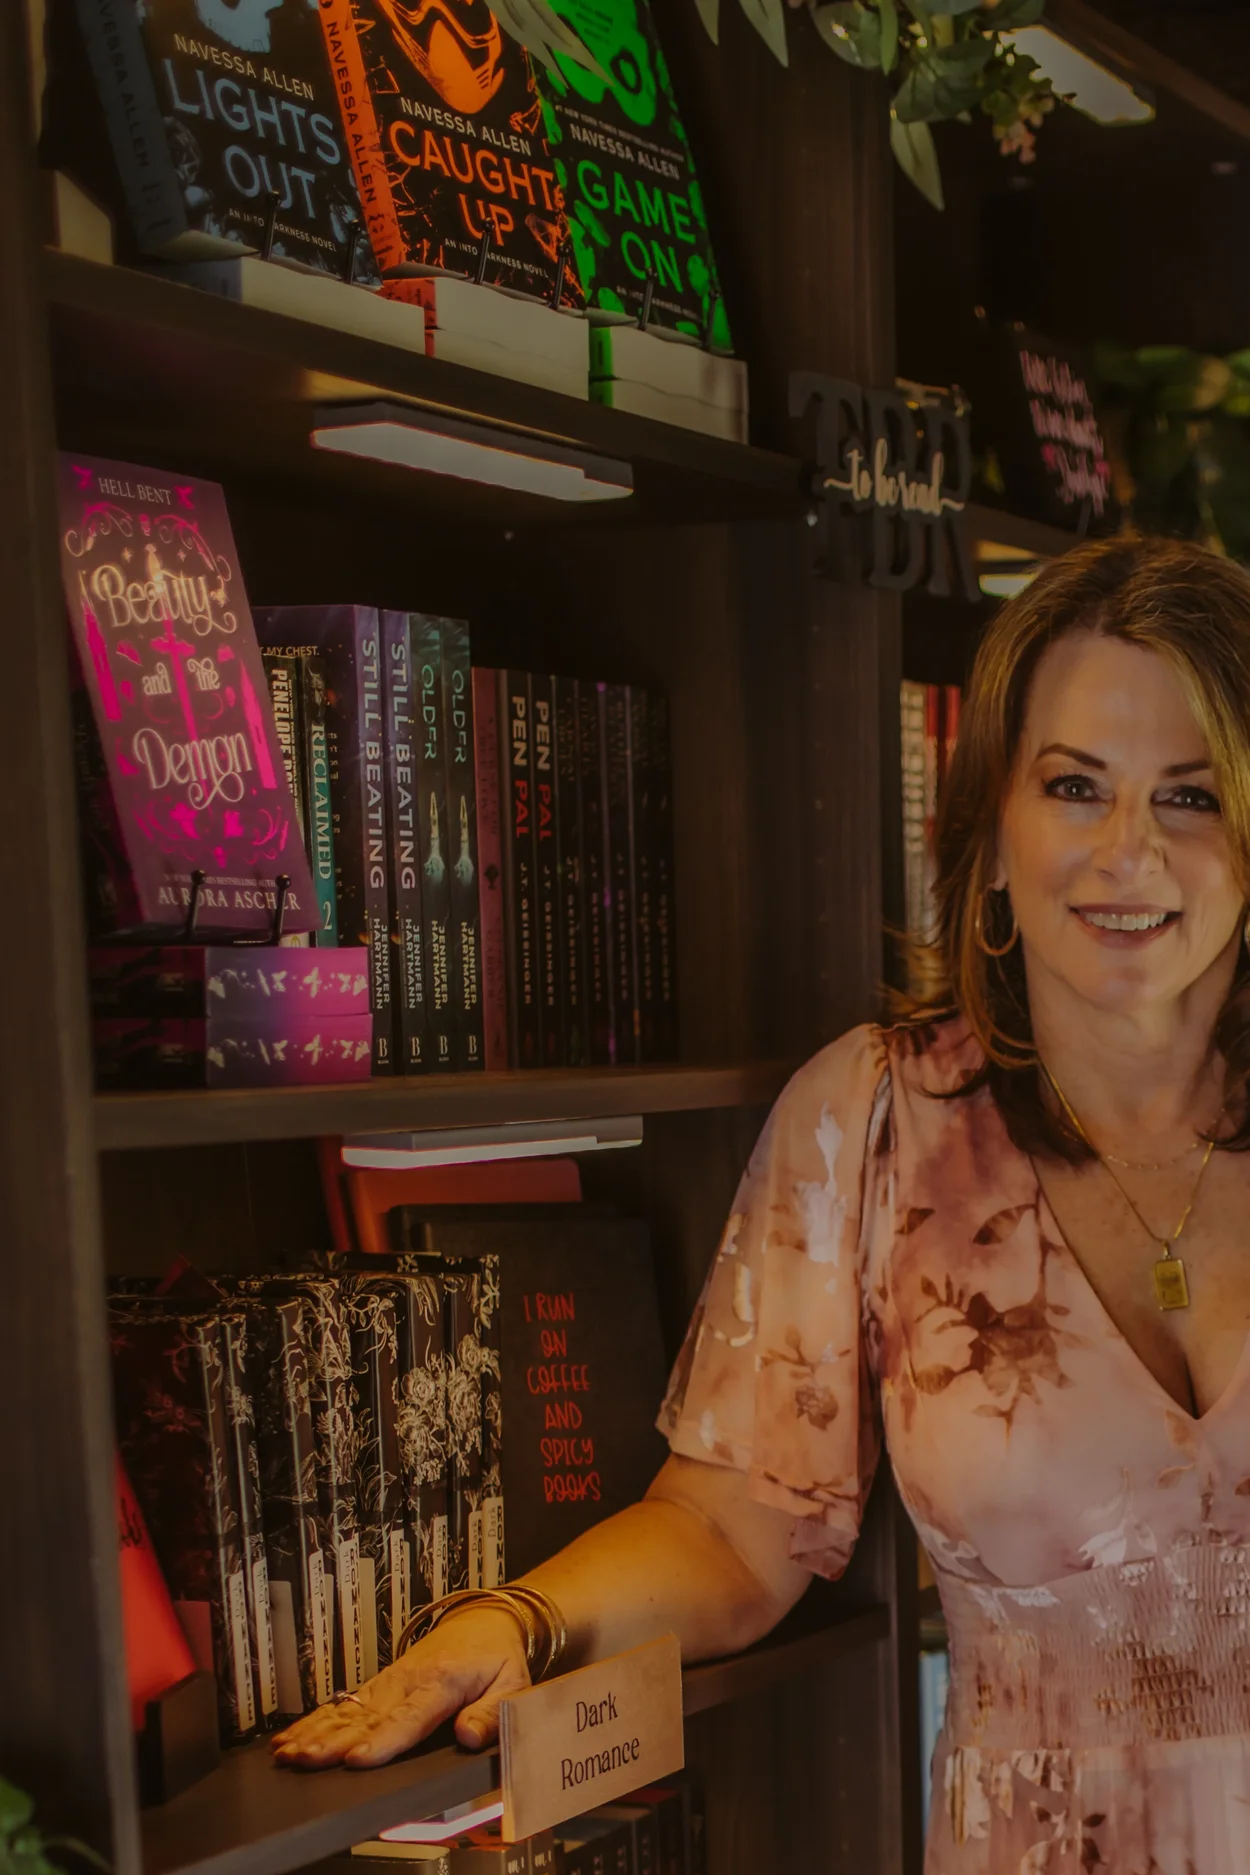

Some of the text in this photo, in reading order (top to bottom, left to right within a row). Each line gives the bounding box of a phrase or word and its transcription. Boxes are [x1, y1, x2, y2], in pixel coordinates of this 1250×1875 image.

[173, 33, 315, 101] NAVESSA ALLEN
[120, 92, 150, 167] ALLEN
[163, 58, 341, 165] LIGHTS
[326, 21, 378, 204] NAVESSA ALLEN
[400, 96, 533, 156] NAVESSA ALLEN
[224, 144, 316, 220] OUT
[388, 120, 554, 211] CAUGHT
[569, 123, 680, 181] NAVESSA ALLEN
[273, 222, 311, 244] ARKNESS
[312, 235, 338, 252] NOVEL
[458, 192, 515, 247] UP
[576, 158, 697, 246] GAME
[444, 238, 549, 278] AN INTO ARKNESS NOVEL
[620, 230, 684, 294] ON
[98, 476, 173, 506] HELL BENT
[91, 564, 237, 636] Beauty
[141, 657, 221, 697] and the
[266, 645, 320, 657] MY CHEST.
[271, 669, 292, 754] PENELOPE
[535, 700, 551, 771] PEN
[132, 727, 252, 810] Demon
[362, 639, 386, 888] STILL BEATING
[391, 642, 416, 890] STILL BEATING
[311, 723, 333, 930] RECLAIMED 2
[537, 783, 553, 842] PAL
[512, 695, 532, 1004] PEN PAL J.T. GEISSINGER
[234, 890, 301, 912] ASCHR
[373, 918, 383, 1010] HARTMANN
[381, 925, 390, 1003] JENNIFER
[405, 918, 416, 1009] HARTMANN
[413, 925, 423, 1003] JENNIFER
[431, 920, 441, 1010] HARTMANN
[439, 926, 448, 1004] JENNIFER
[461, 921, 471, 1010] HARTMANN
[468, 928, 477, 1004] JENNIFER
[545, 900, 554, 1006] GEISSINGER
[523, 1291, 575, 1322] I RUN
[541, 1329, 567, 1357] ON
[527, 1364, 592, 1395] COFFEE
[545, 1401, 583, 1430] AND
[540, 1437, 595, 1468] SPICY
[543, 1471, 602, 1504] BOOKS
[488, 1506, 496, 1538] Dark
[350, 1548, 362, 1685] ROMANCE
[575, 1691, 618, 1733] Dark
[560, 1737, 640, 1791] Romance
